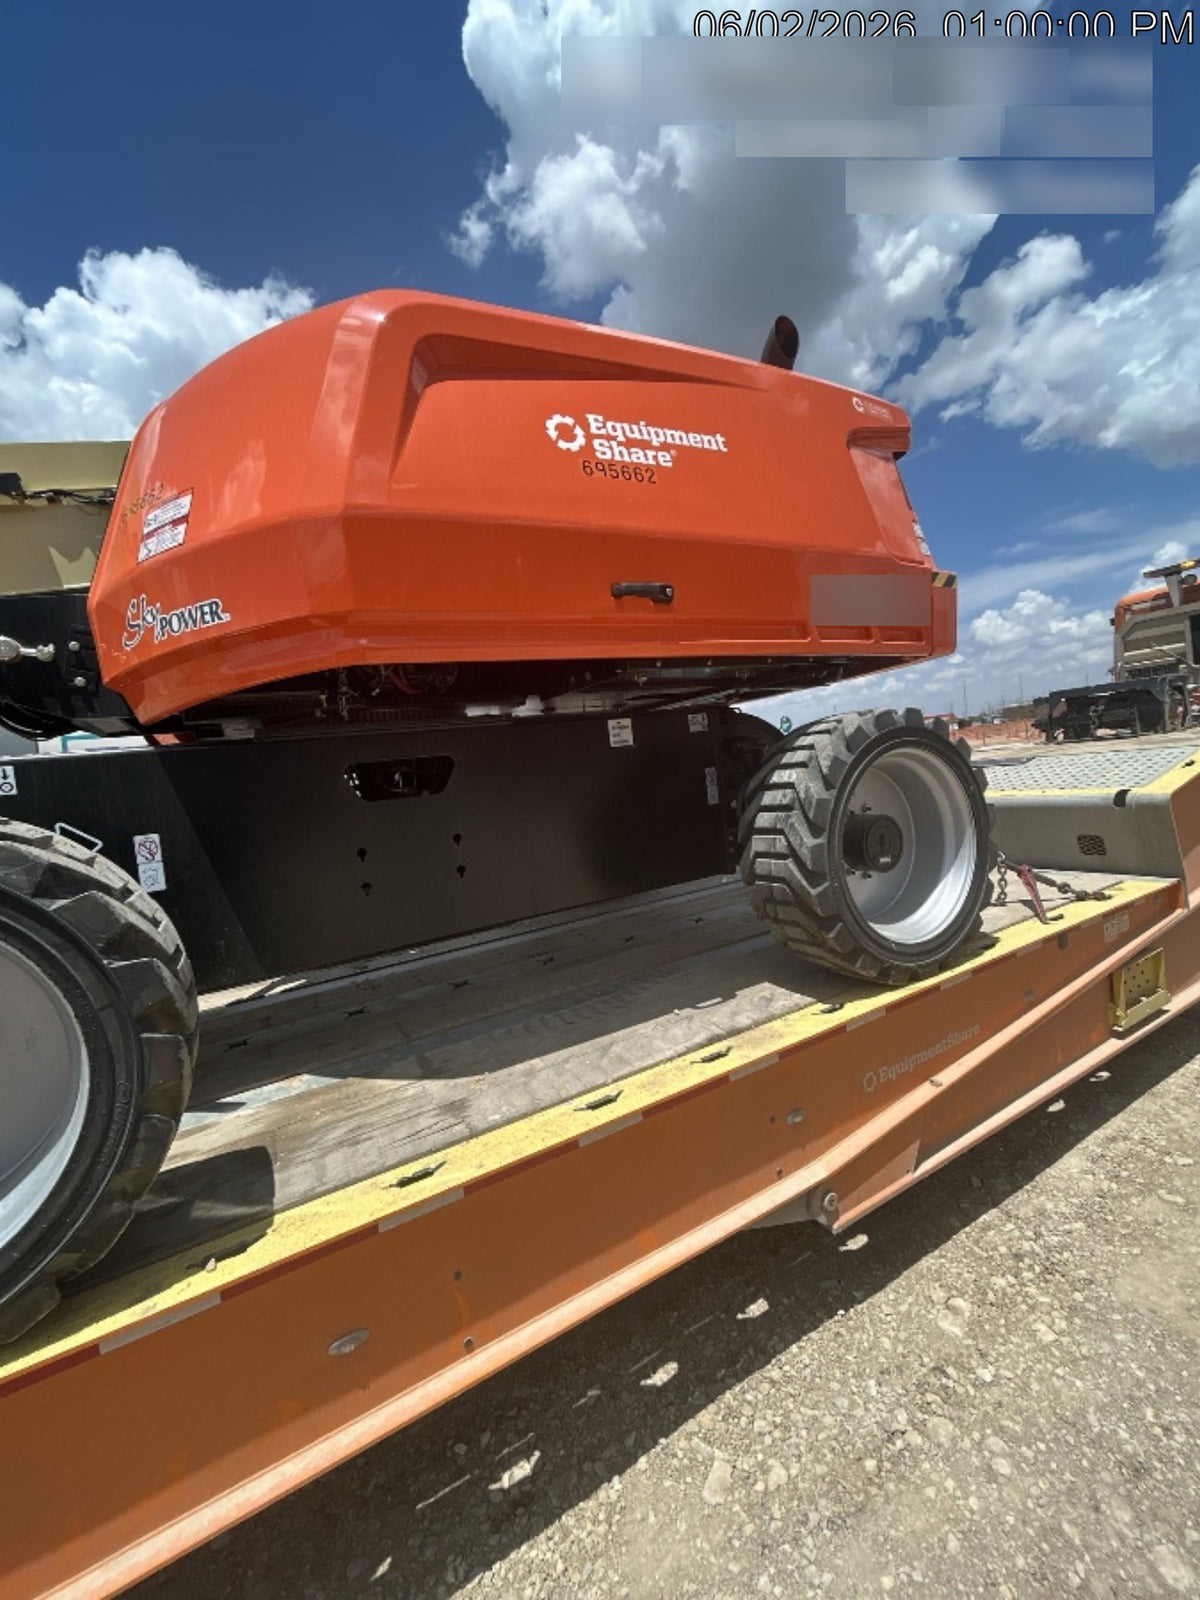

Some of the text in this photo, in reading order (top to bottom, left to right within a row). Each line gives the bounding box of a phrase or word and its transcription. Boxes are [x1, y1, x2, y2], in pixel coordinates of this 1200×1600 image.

[584, 413, 728, 452] Equipment
[582, 459, 657, 484] 695662
[878, 1023, 981, 1083] EquipmentShare
